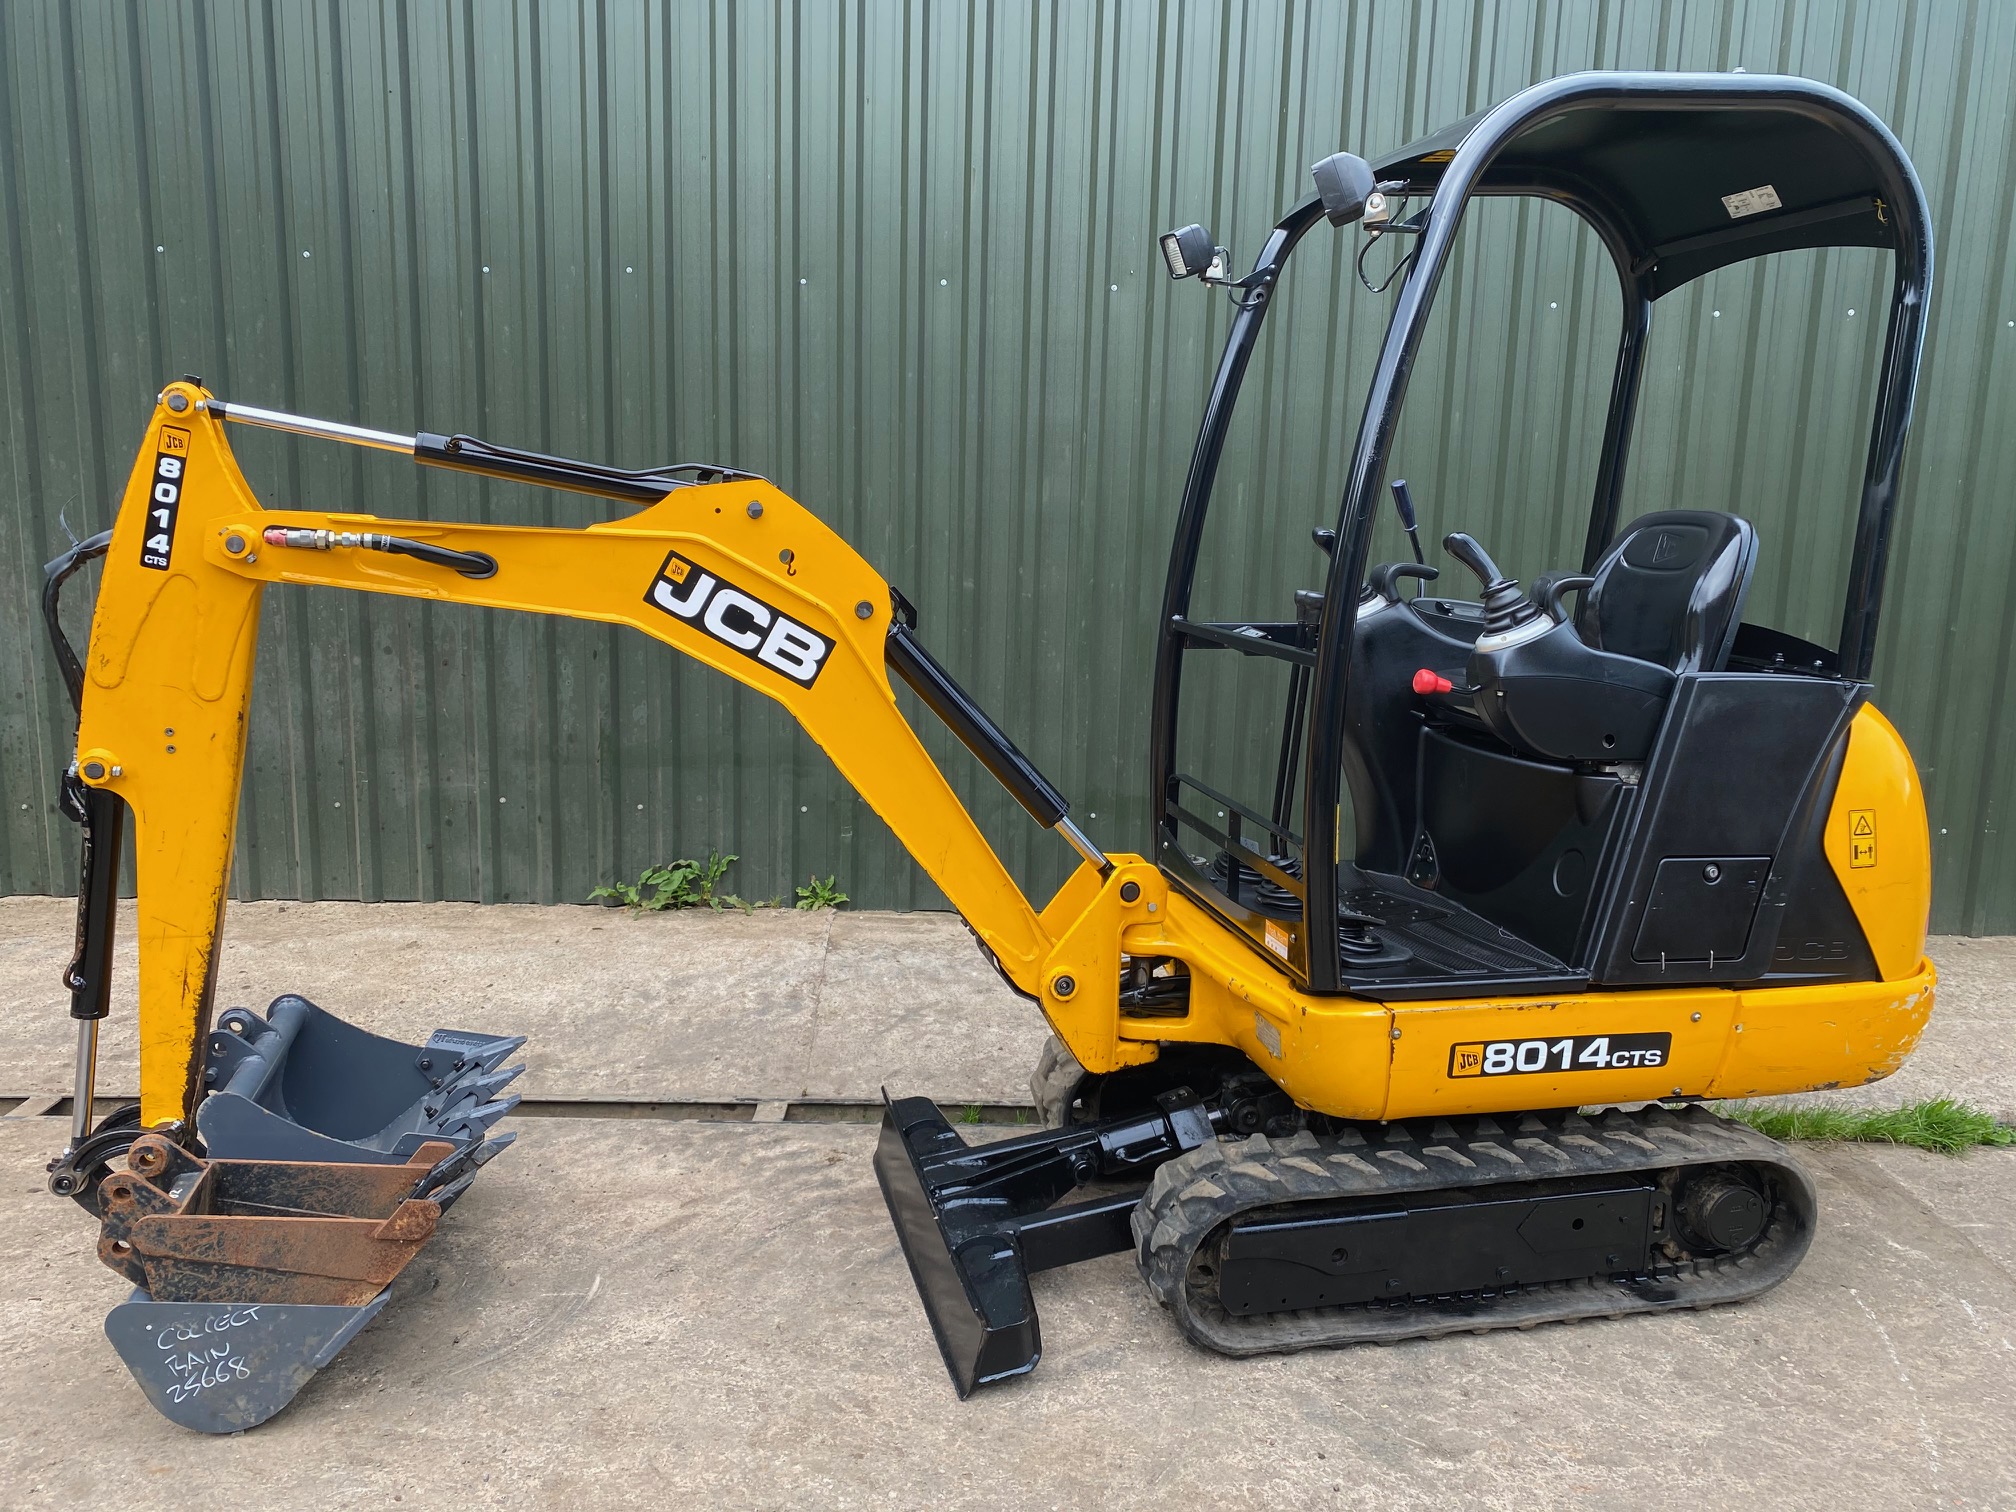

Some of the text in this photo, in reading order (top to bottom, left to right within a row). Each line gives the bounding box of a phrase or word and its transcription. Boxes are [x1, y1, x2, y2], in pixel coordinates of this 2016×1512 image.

[165, 434, 184, 449] JCB
[146, 457, 182, 554] 8014
[144, 554, 167, 566] CTS
[653, 573, 826, 680] JCB
[1459, 1053, 1480, 1071] JCB
